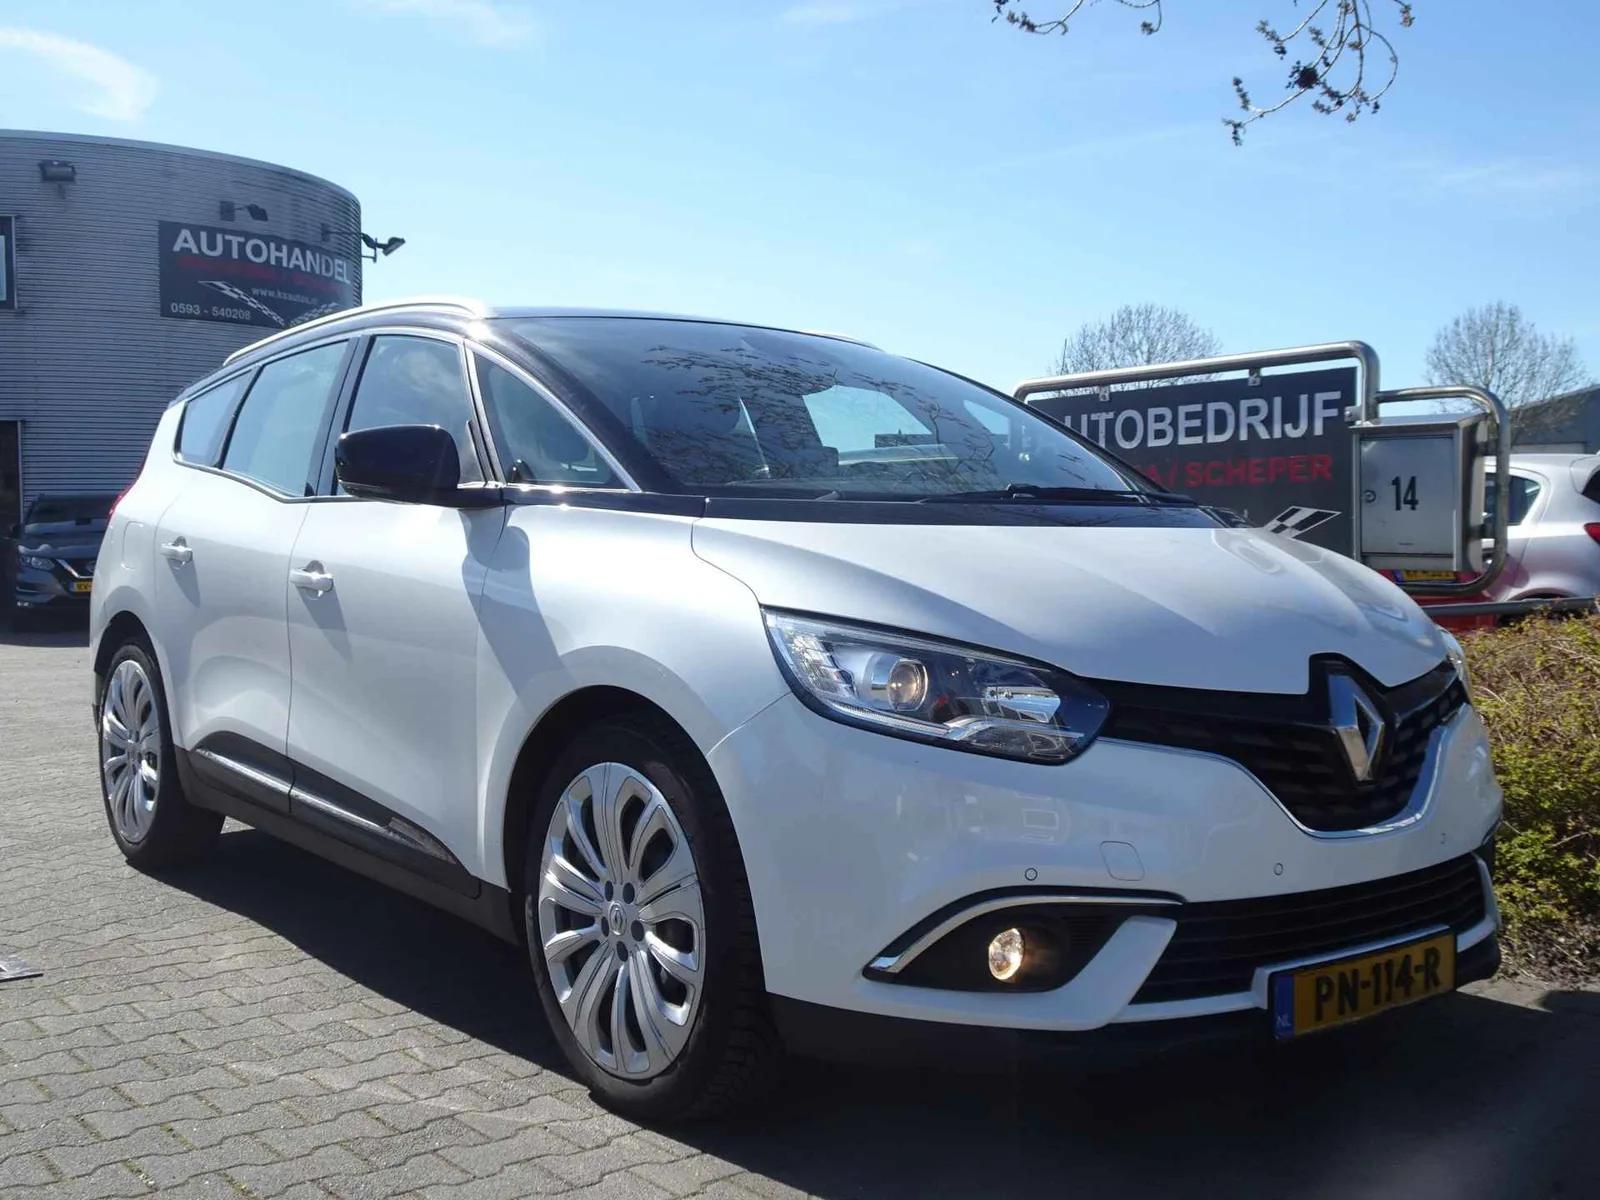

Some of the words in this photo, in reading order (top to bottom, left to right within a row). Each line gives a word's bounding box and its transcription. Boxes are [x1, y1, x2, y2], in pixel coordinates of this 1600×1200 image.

[172, 229, 350, 285] AUTOHANDEL
[170, 302, 201, 315] 0593
[211, 306, 252, 320] 540208
[1185, 454, 1334, 488] SCHEPER
[1391, 475, 1419, 511] 14
[1314, 947, 1442, 1022] PN-114-R
[1275, 1012, 1292, 1028] NL
